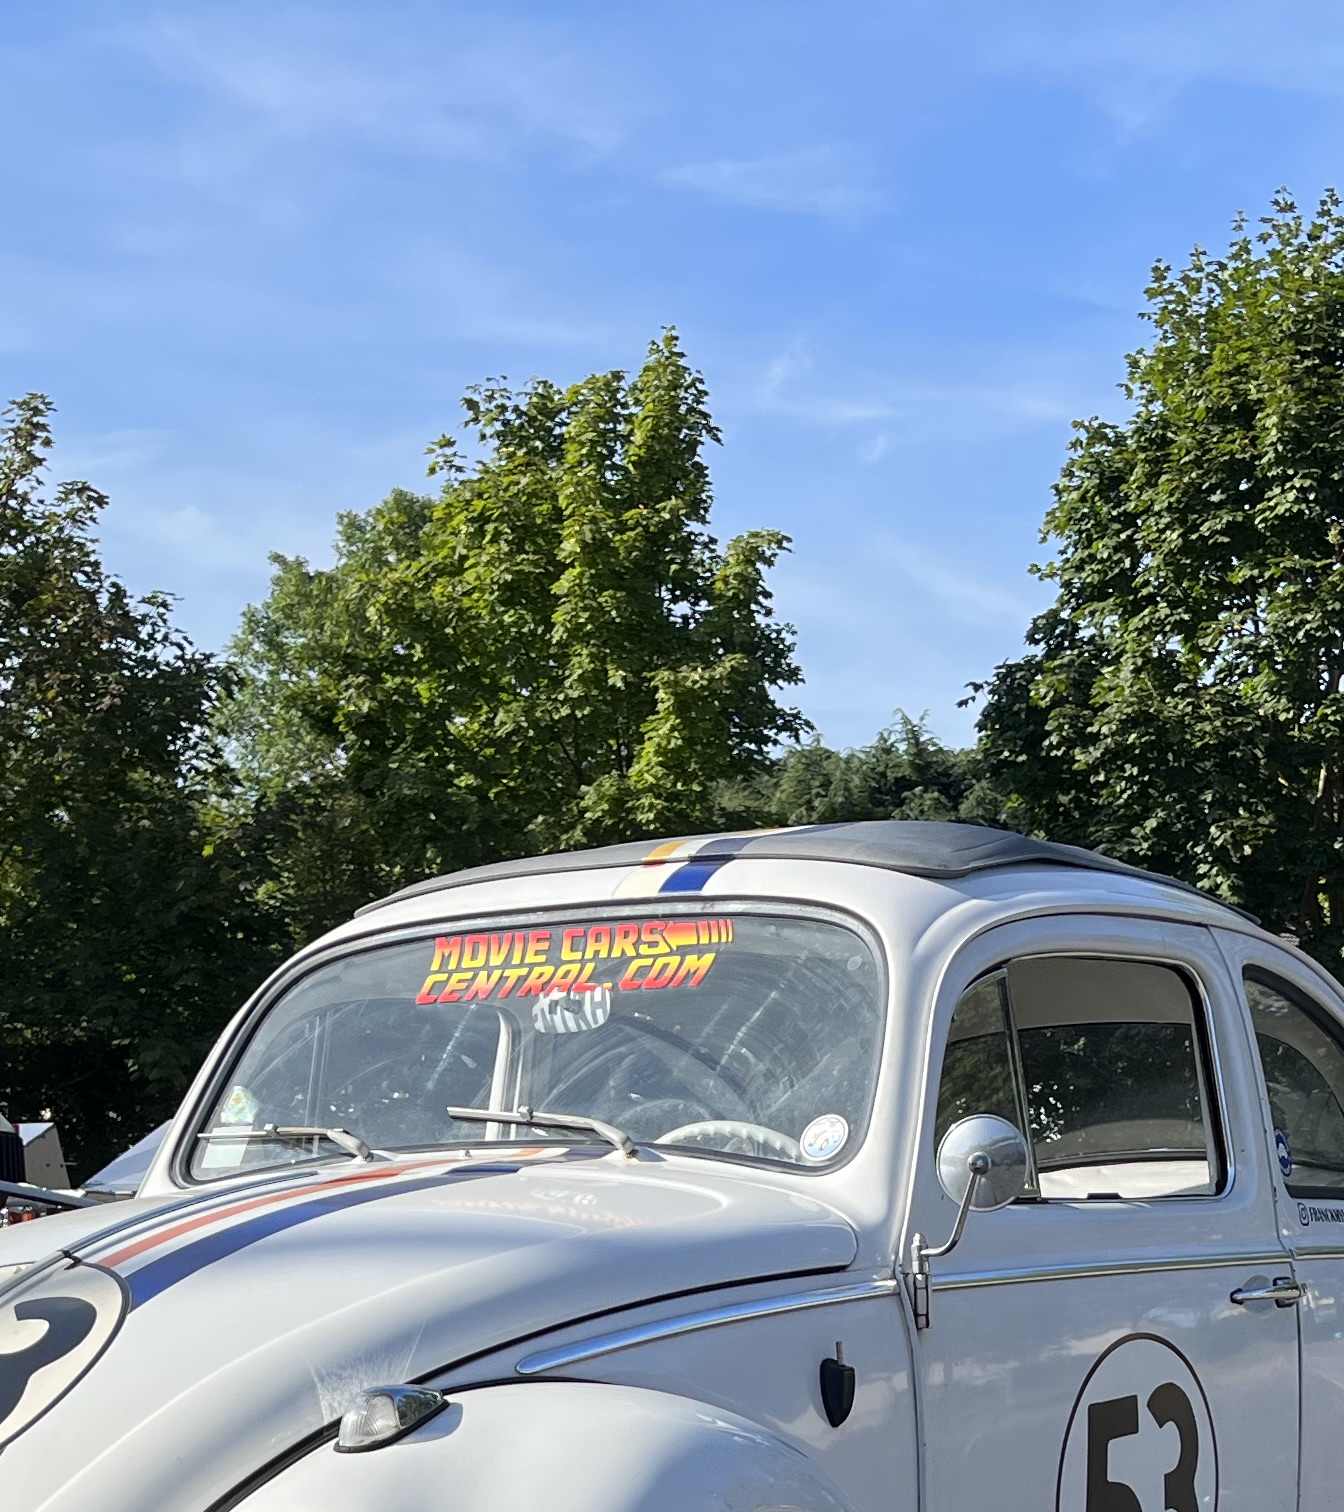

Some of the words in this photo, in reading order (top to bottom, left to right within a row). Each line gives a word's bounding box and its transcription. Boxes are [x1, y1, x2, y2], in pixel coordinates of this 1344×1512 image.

[430, 930, 551, 970] MOVIE
[562, 921, 671, 960] CARS
[415, 953, 716, 1005] CENTRAL.COM
